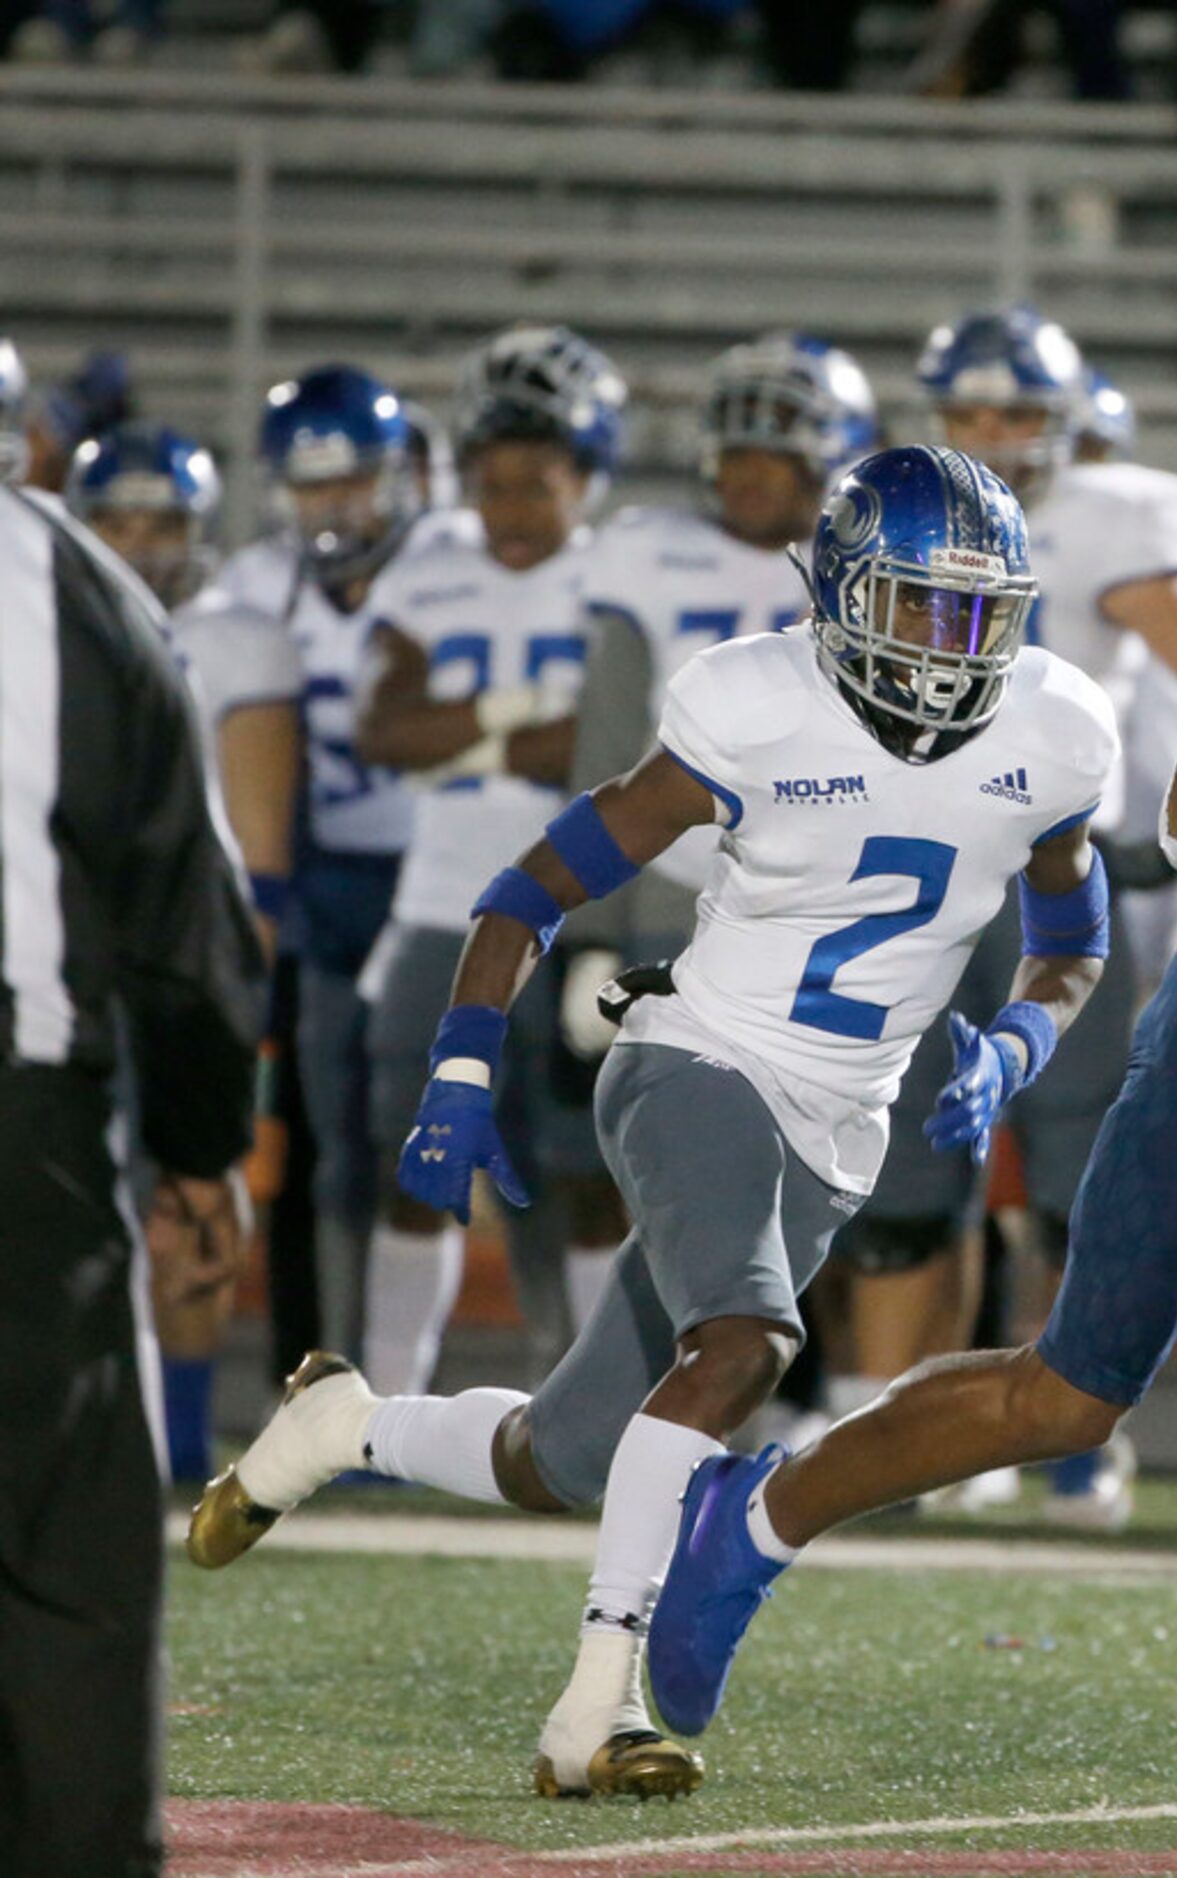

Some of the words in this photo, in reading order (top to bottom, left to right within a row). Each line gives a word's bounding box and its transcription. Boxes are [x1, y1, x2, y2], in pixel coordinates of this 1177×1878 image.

[947, 552, 990, 570] Riddell
[773, 774, 866, 796] NOLAN
[979, 783, 1032, 805] adidas
[788, 835, 959, 1041] 2
